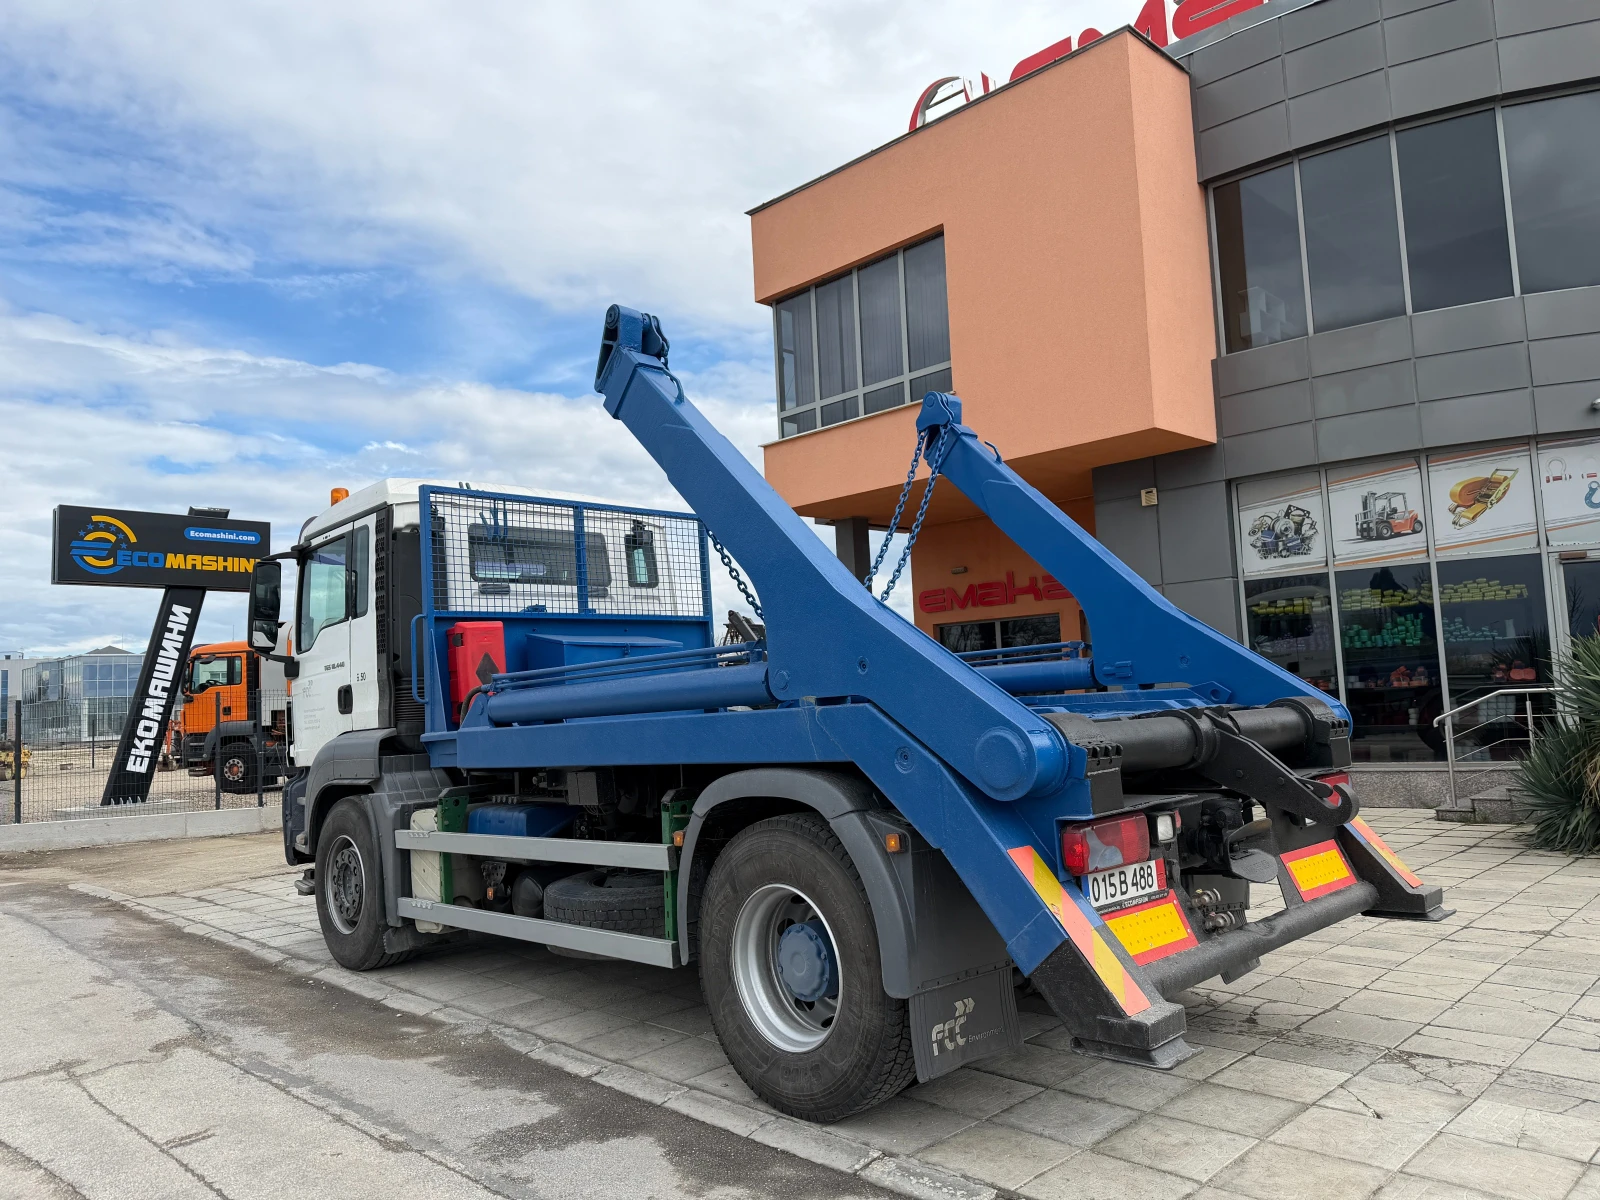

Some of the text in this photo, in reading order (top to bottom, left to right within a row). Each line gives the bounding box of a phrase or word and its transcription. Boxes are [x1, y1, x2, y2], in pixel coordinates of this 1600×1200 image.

[189, 530, 256, 542] Ecomashini.com
[116, 550, 259, 573] ECOMASHIN
[125, 603, 192, 774] ЕКОМАШИНИ
[968, 1026, 1005, 1043] Environment
